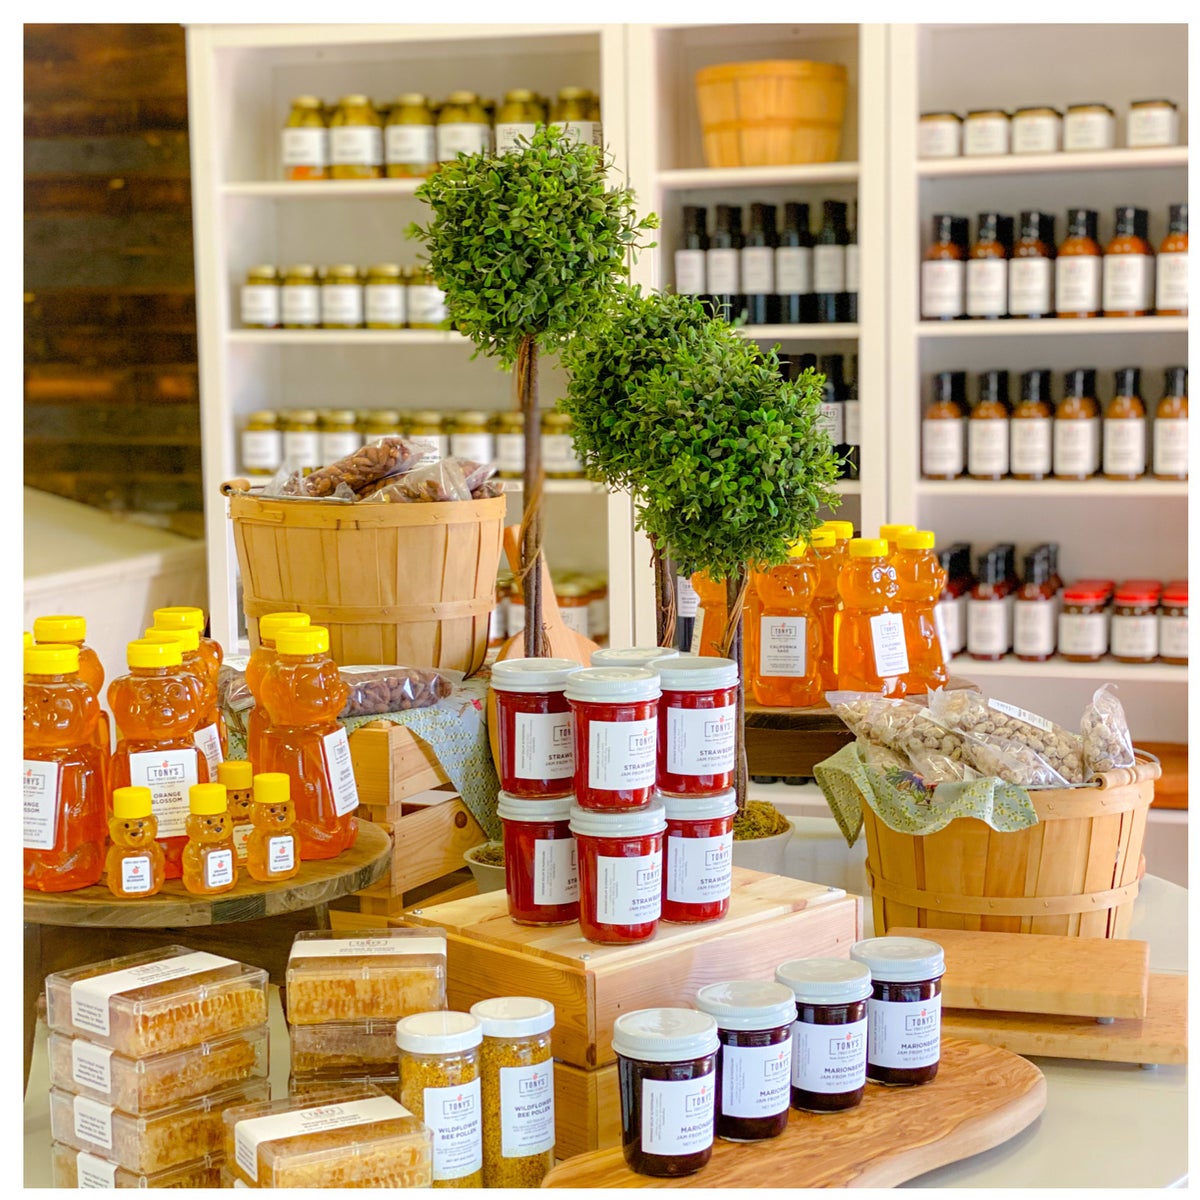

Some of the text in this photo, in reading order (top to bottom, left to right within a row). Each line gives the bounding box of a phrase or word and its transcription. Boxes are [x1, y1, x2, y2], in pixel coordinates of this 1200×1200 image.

[153, 769, 179, 777] TONY'S
[152, 797, 183, 805] BLOSSOM
[912, 1016, 934, 1027] TONY'S
[836, 1039, 860, 1050] TONY'S
[531, 1106, 551, 1117] POLLEN
[441, 1127, 477, 1140] BEE POLLEN
